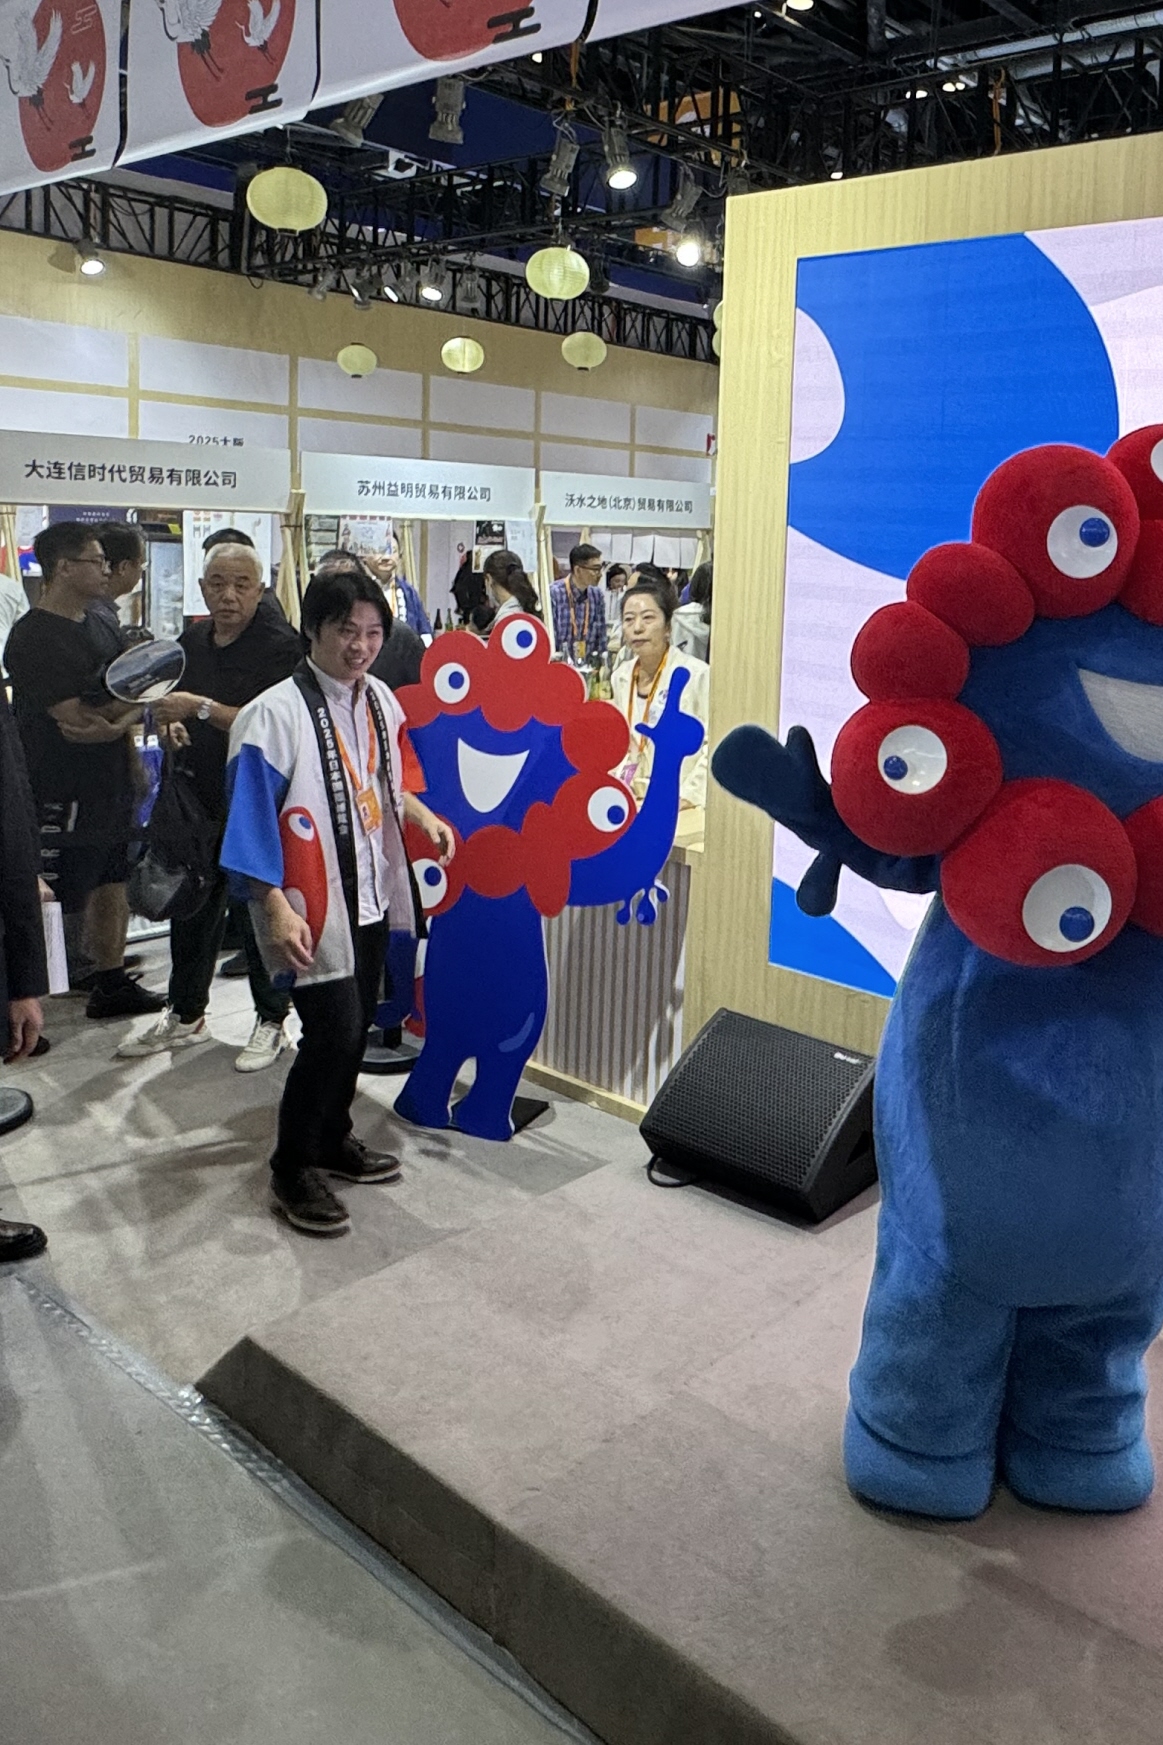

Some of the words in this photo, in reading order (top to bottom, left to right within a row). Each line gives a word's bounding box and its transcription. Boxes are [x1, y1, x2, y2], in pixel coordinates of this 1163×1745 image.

[23, 458, 238, 489] 大连信时代贸易有限公司
[357, 479, 492, 503] 苏州益明贸易有限公司
